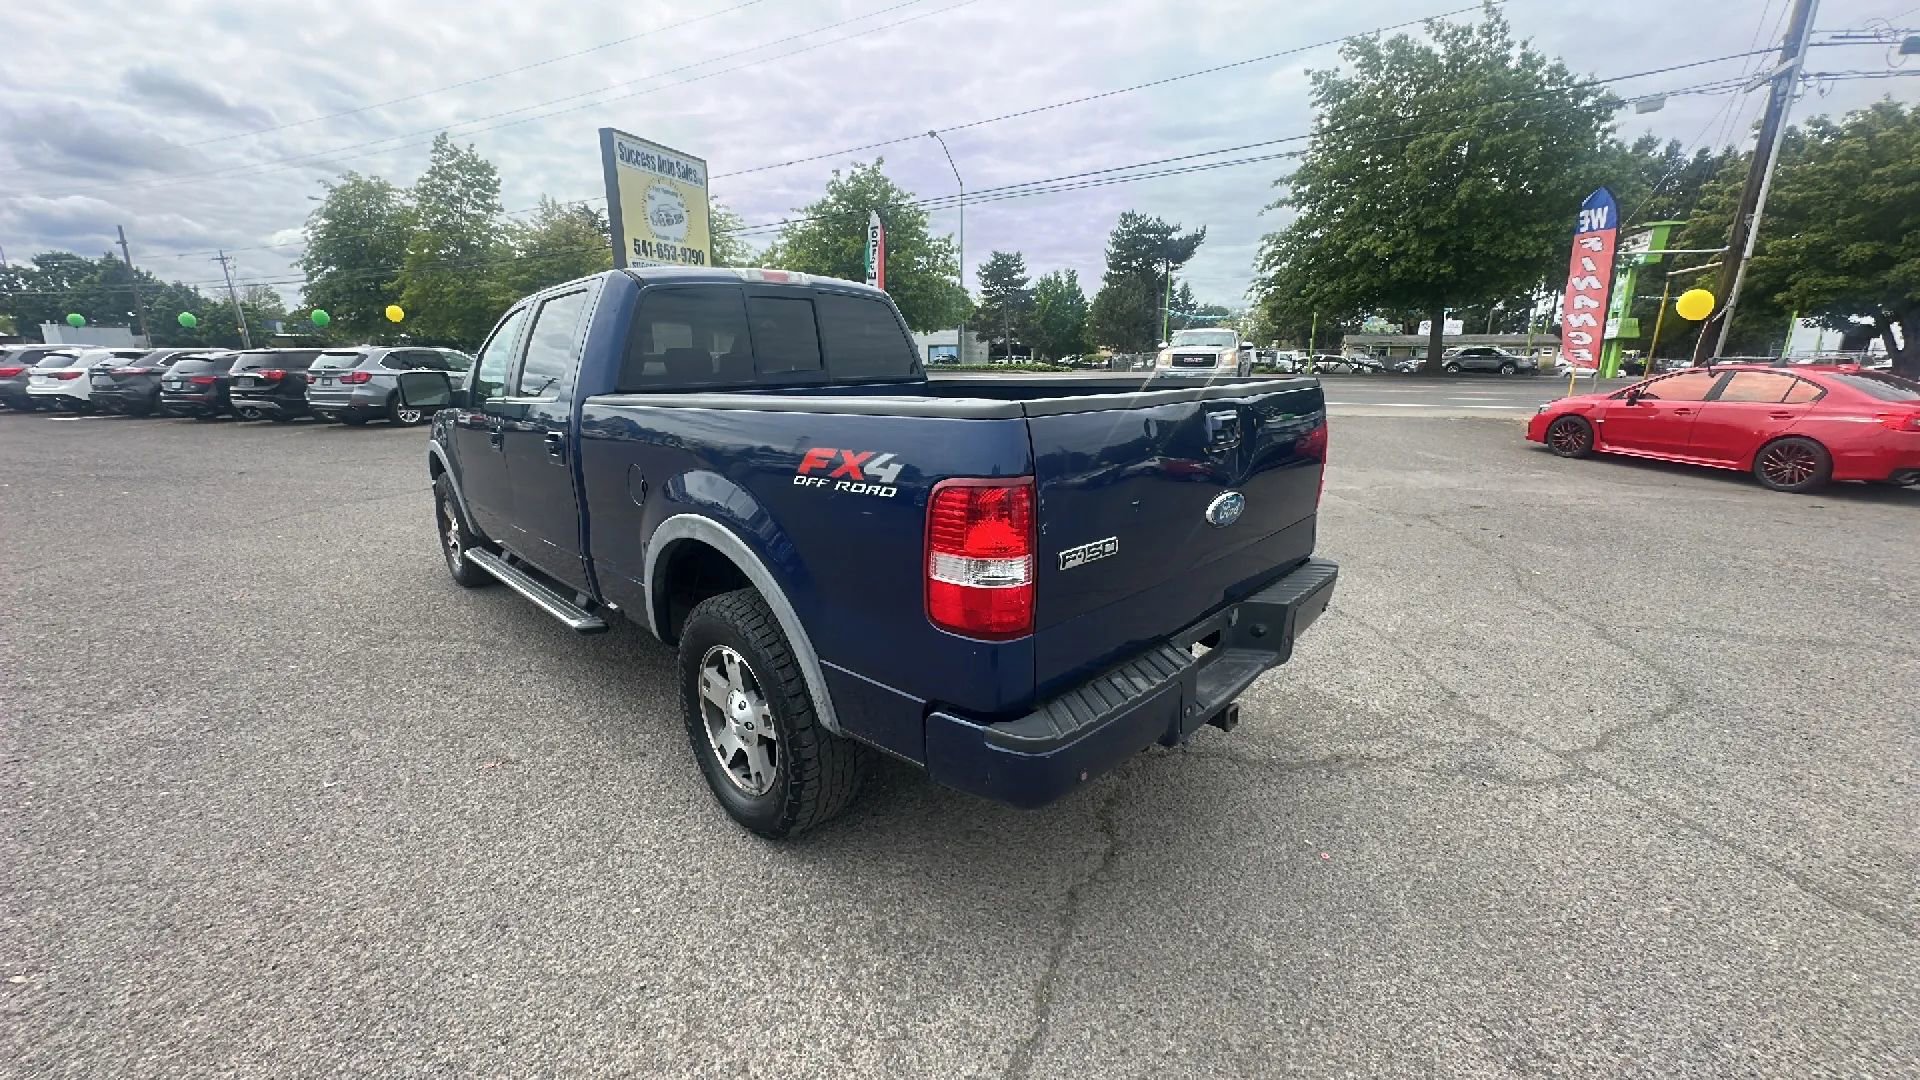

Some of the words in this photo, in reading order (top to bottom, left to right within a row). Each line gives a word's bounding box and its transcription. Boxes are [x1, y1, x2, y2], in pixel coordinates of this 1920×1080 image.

[618, 142, 656, 172] Success
[657, 154, 675, 176] Auto
[676, 161, 697, 184] Sales
[633, 238, 704, 265] 541-653-9790
[797, 447, 904, 483] FX4
[793, 475, 830, 487] OFF
[834, 481, 897, 497] ROAD
